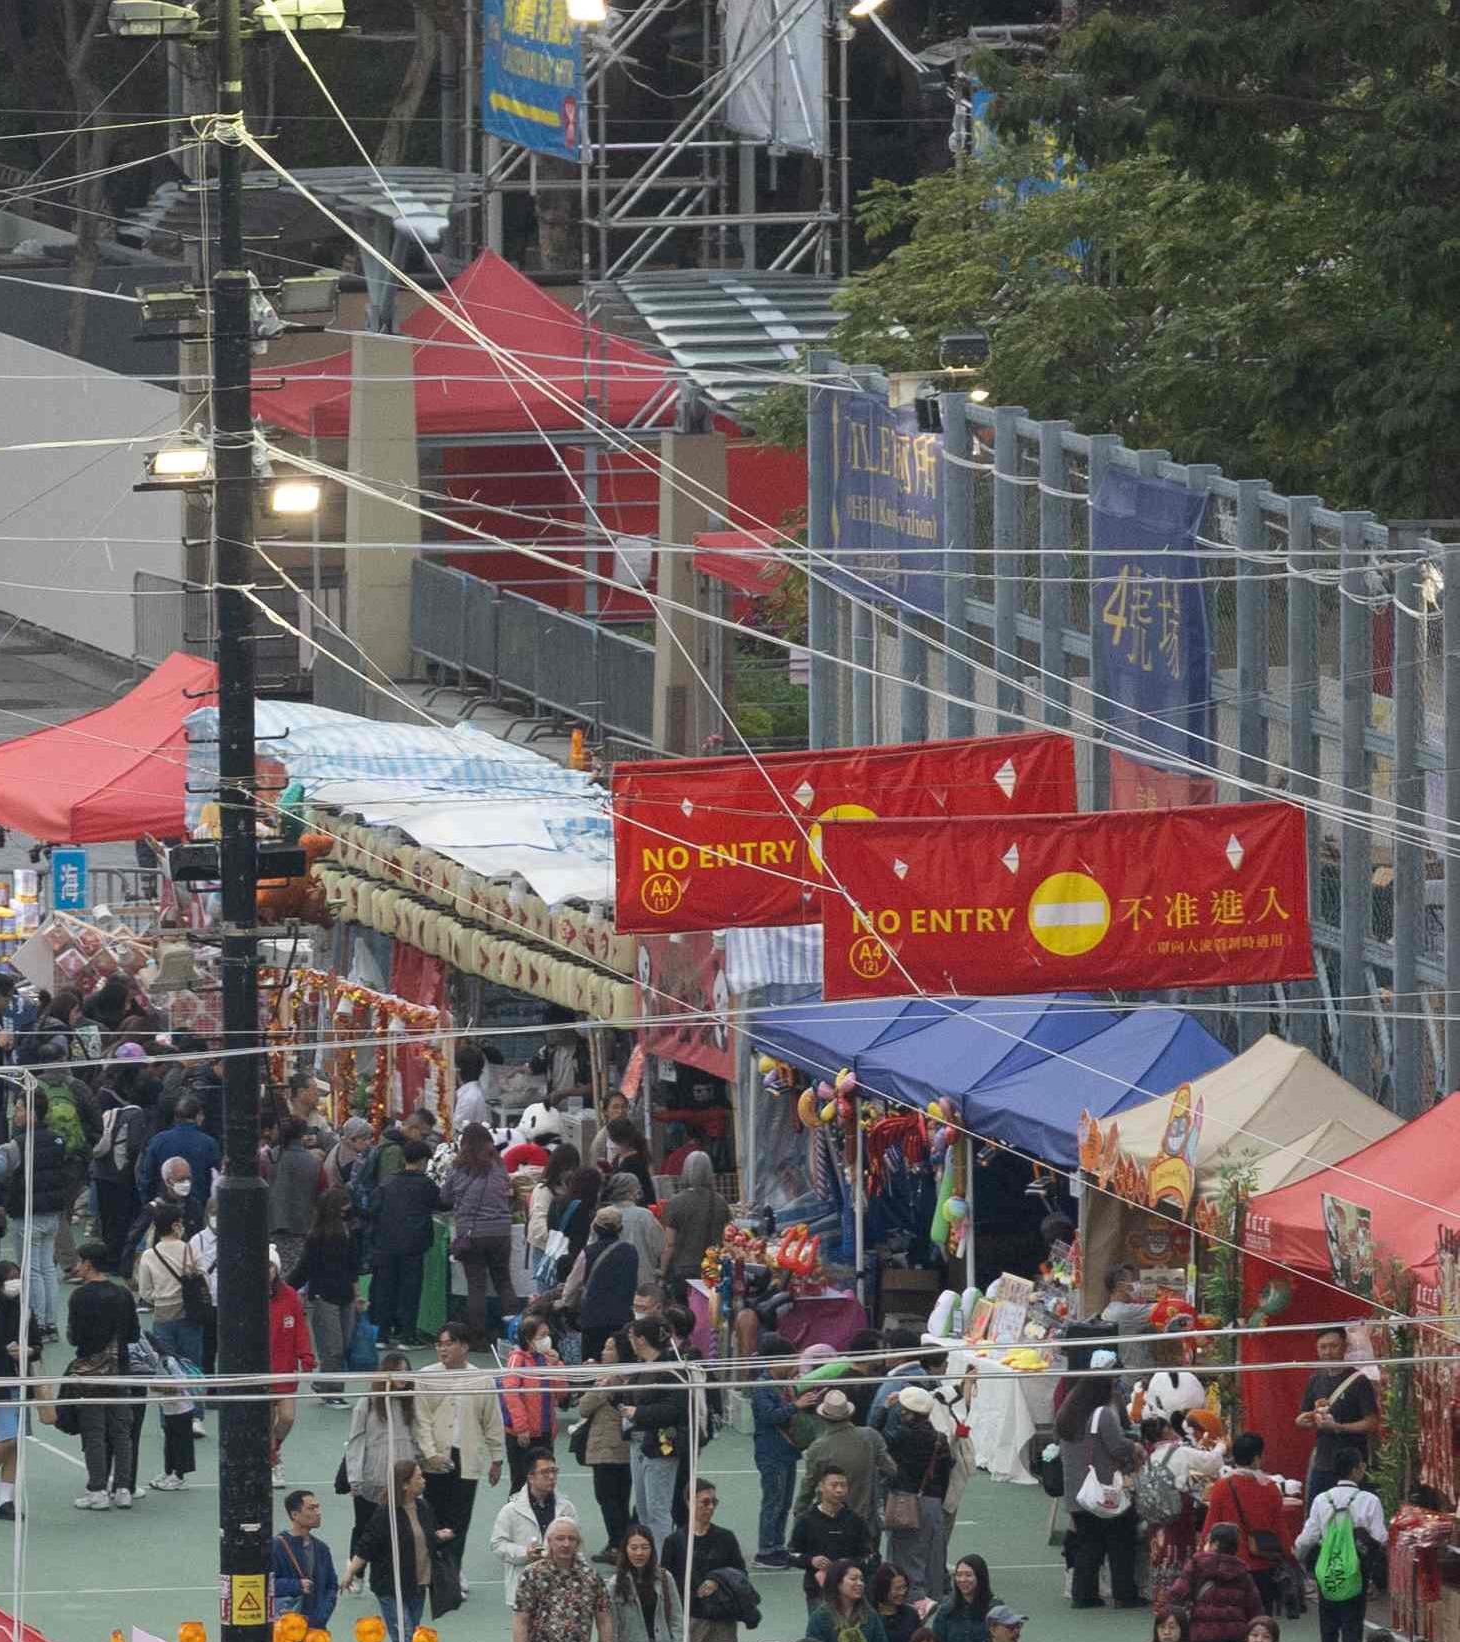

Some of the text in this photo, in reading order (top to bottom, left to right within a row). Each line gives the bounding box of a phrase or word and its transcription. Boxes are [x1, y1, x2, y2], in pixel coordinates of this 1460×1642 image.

[643, 838, 798, 873] NO ENTRY
[651, 882, 673, 898] A4
[852, 907, 1016, 935] NO ENTRY
[1119, 886, 1291, 932] 不准進入
[859, 943, 883, 961] A4
